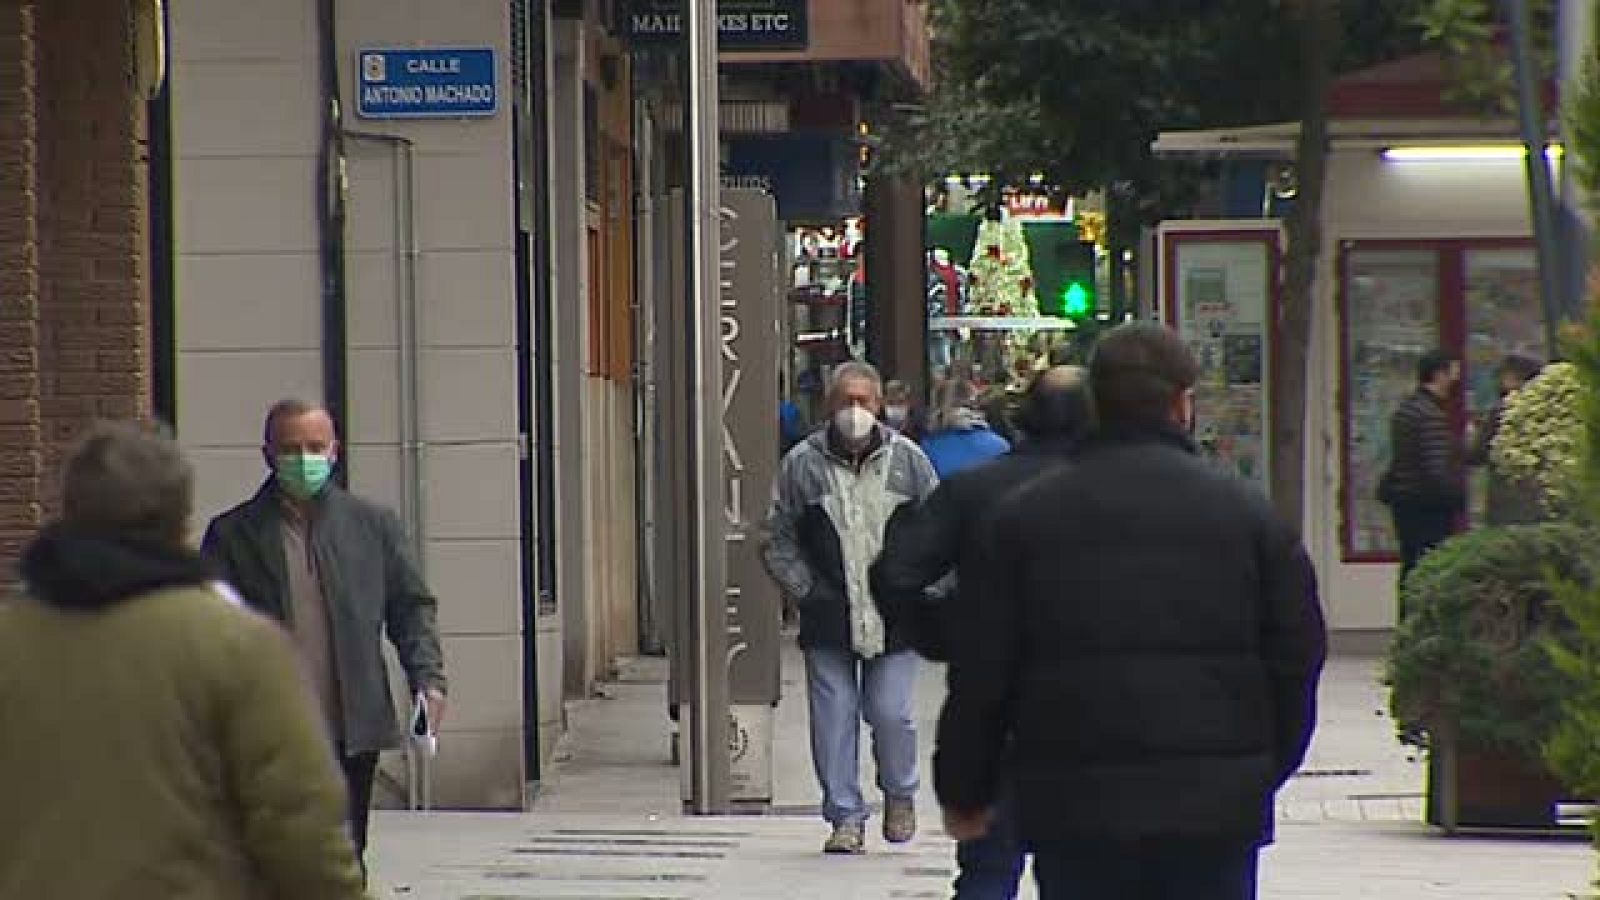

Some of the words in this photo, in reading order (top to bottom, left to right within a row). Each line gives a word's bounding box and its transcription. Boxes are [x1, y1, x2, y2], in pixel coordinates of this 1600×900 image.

[752, 14, 789, 31] ETC
[407, 58, 461, 74] CALLE
[364, 85, 423, 103] ANTONIO
[426, 84, 494, 103] MACHADO
